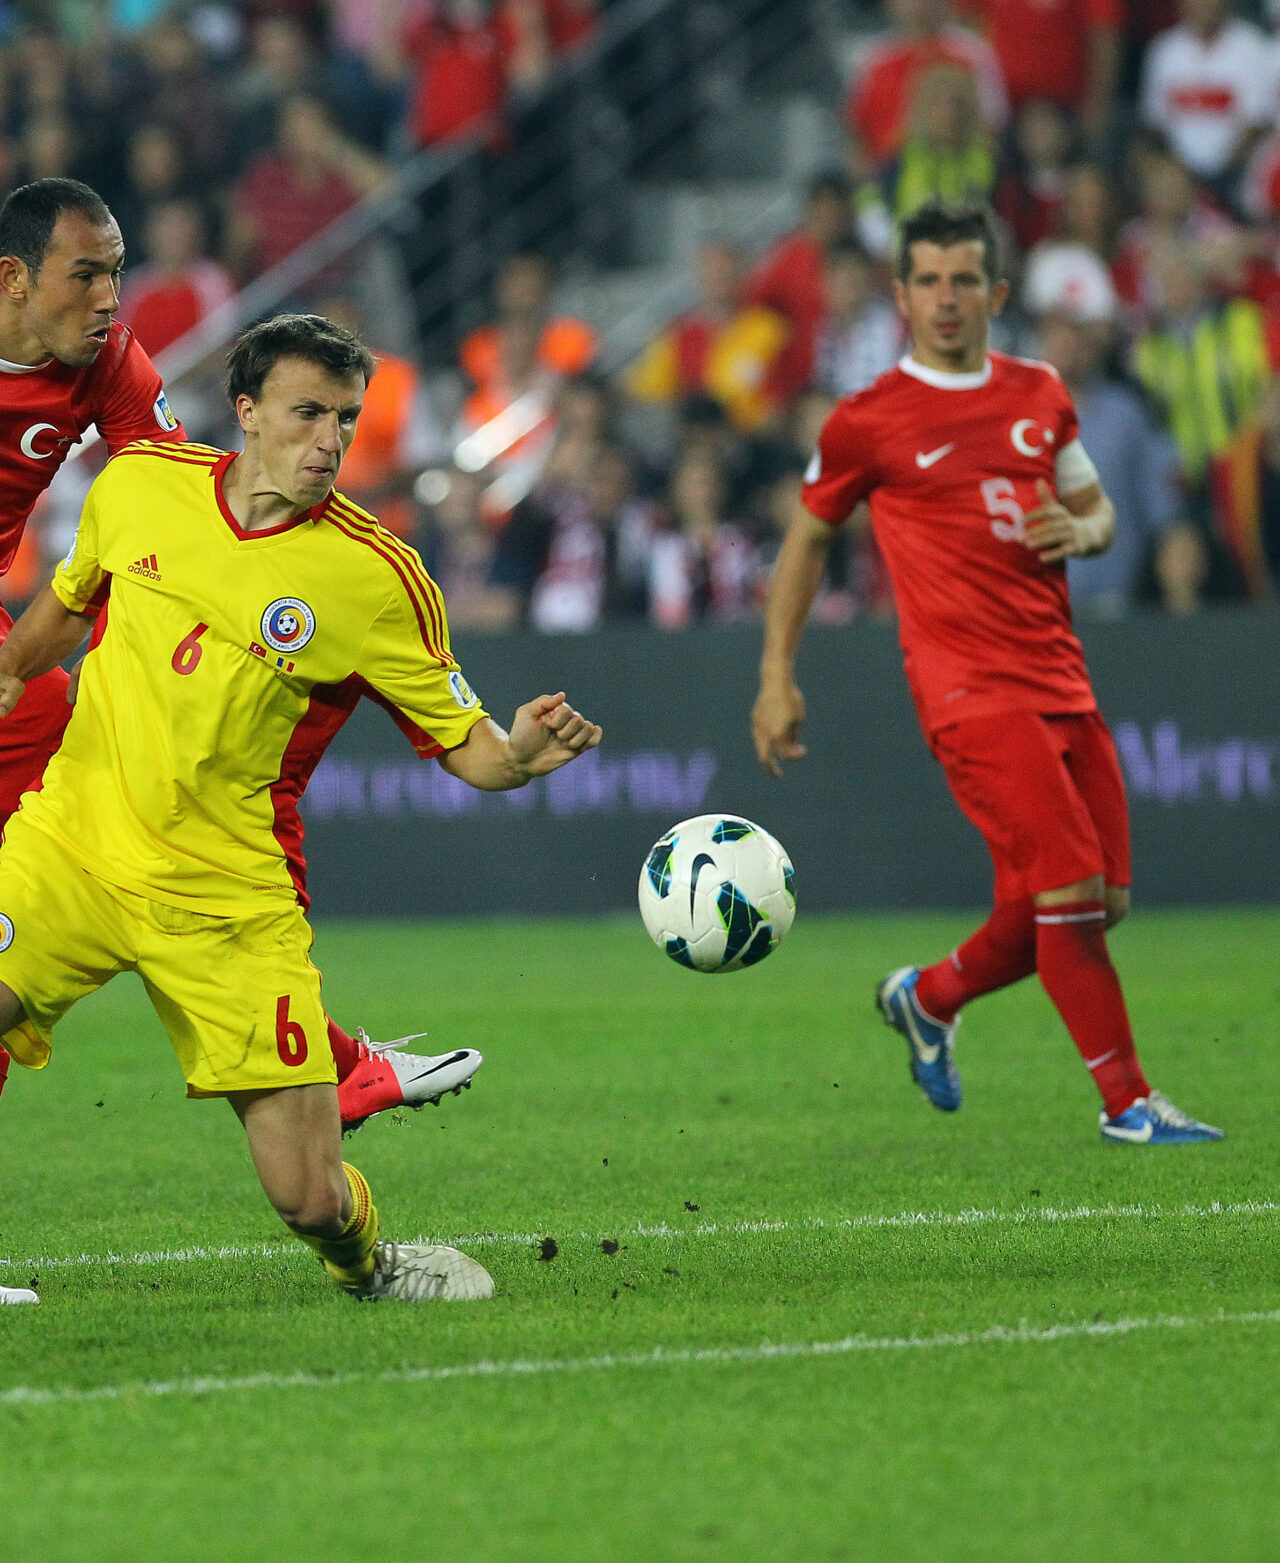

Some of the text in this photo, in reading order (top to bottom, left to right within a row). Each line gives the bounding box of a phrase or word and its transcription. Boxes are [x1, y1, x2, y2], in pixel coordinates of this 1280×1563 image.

[980, 476, 1025, 543] 5
[127, 565, 162, 581] adidas
[171, 621, 210, 675] 6
[276, 994, 308, 1067] 6
